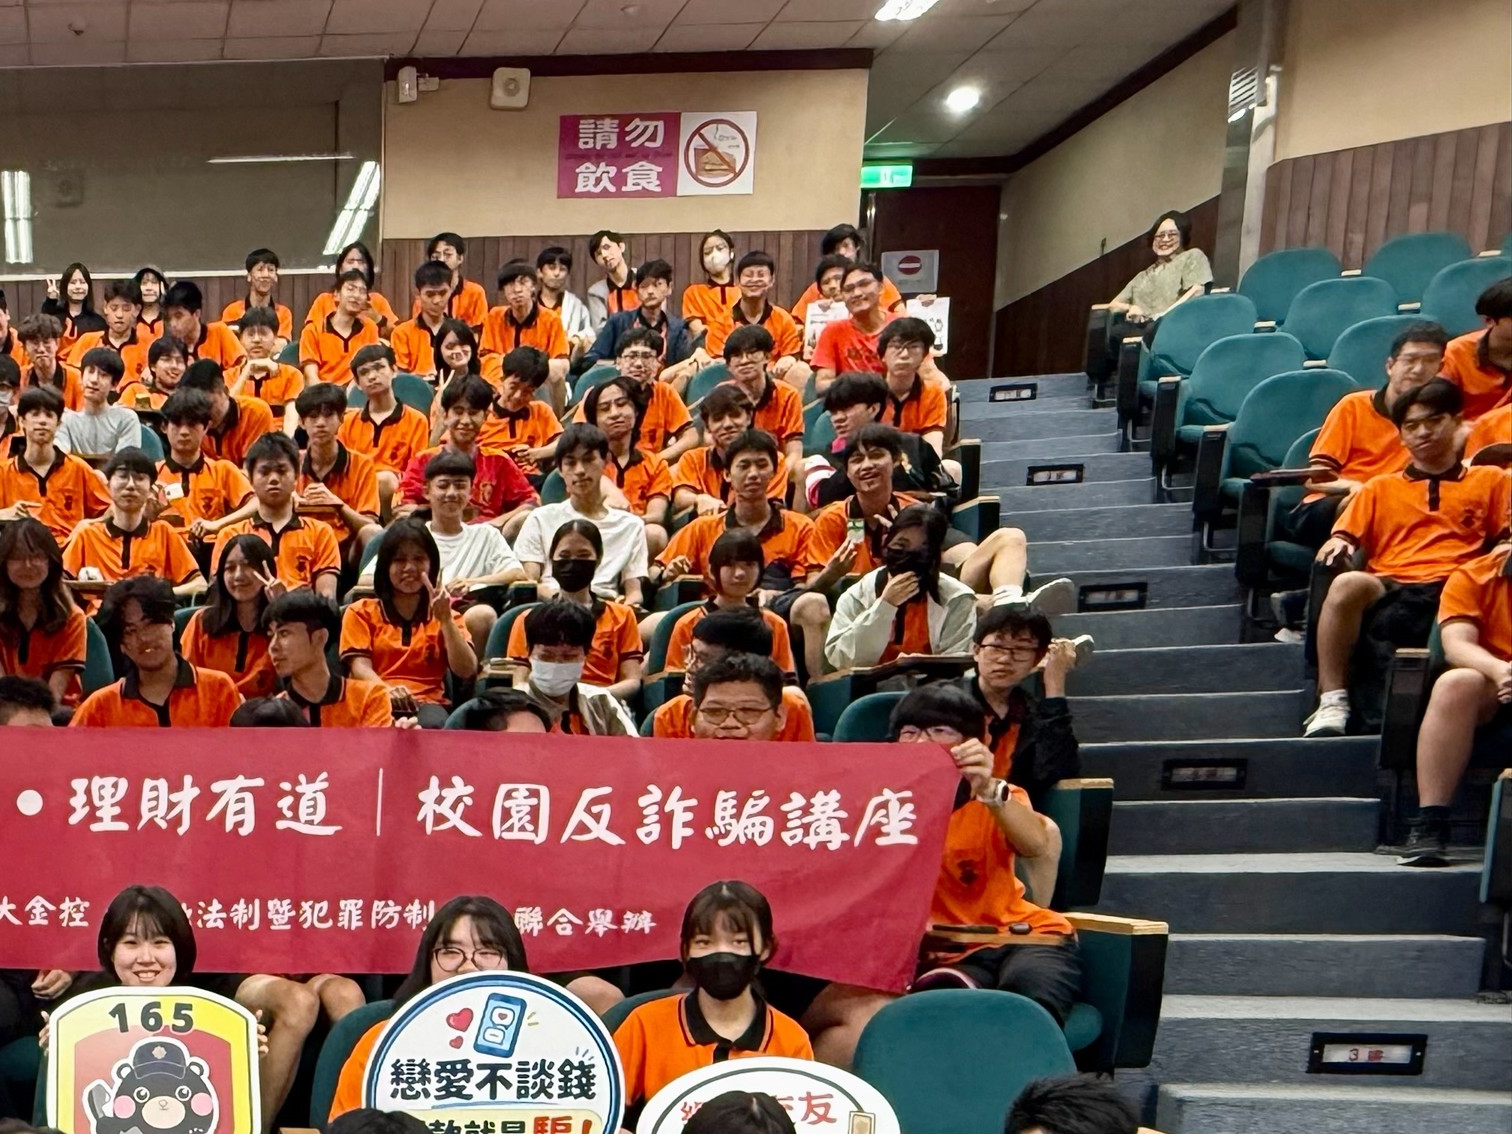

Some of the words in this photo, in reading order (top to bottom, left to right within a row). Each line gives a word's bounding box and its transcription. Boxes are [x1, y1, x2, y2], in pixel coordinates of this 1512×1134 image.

[578, 117, 665, 150] 請勿
[574, 160, 663, 193] 飲食
[67, 771, 343, 837] 理財有道
[416, 774, 920, 852] 校園反詐騙講座
[180, 898, 435, 931] 法制暨犯罪防制
[513, 906, 657, 938] 聯合舉辦
[108, 1001, 194, 1034] 165
[389, 1057, 597, 1100] 戀愛不談錢
